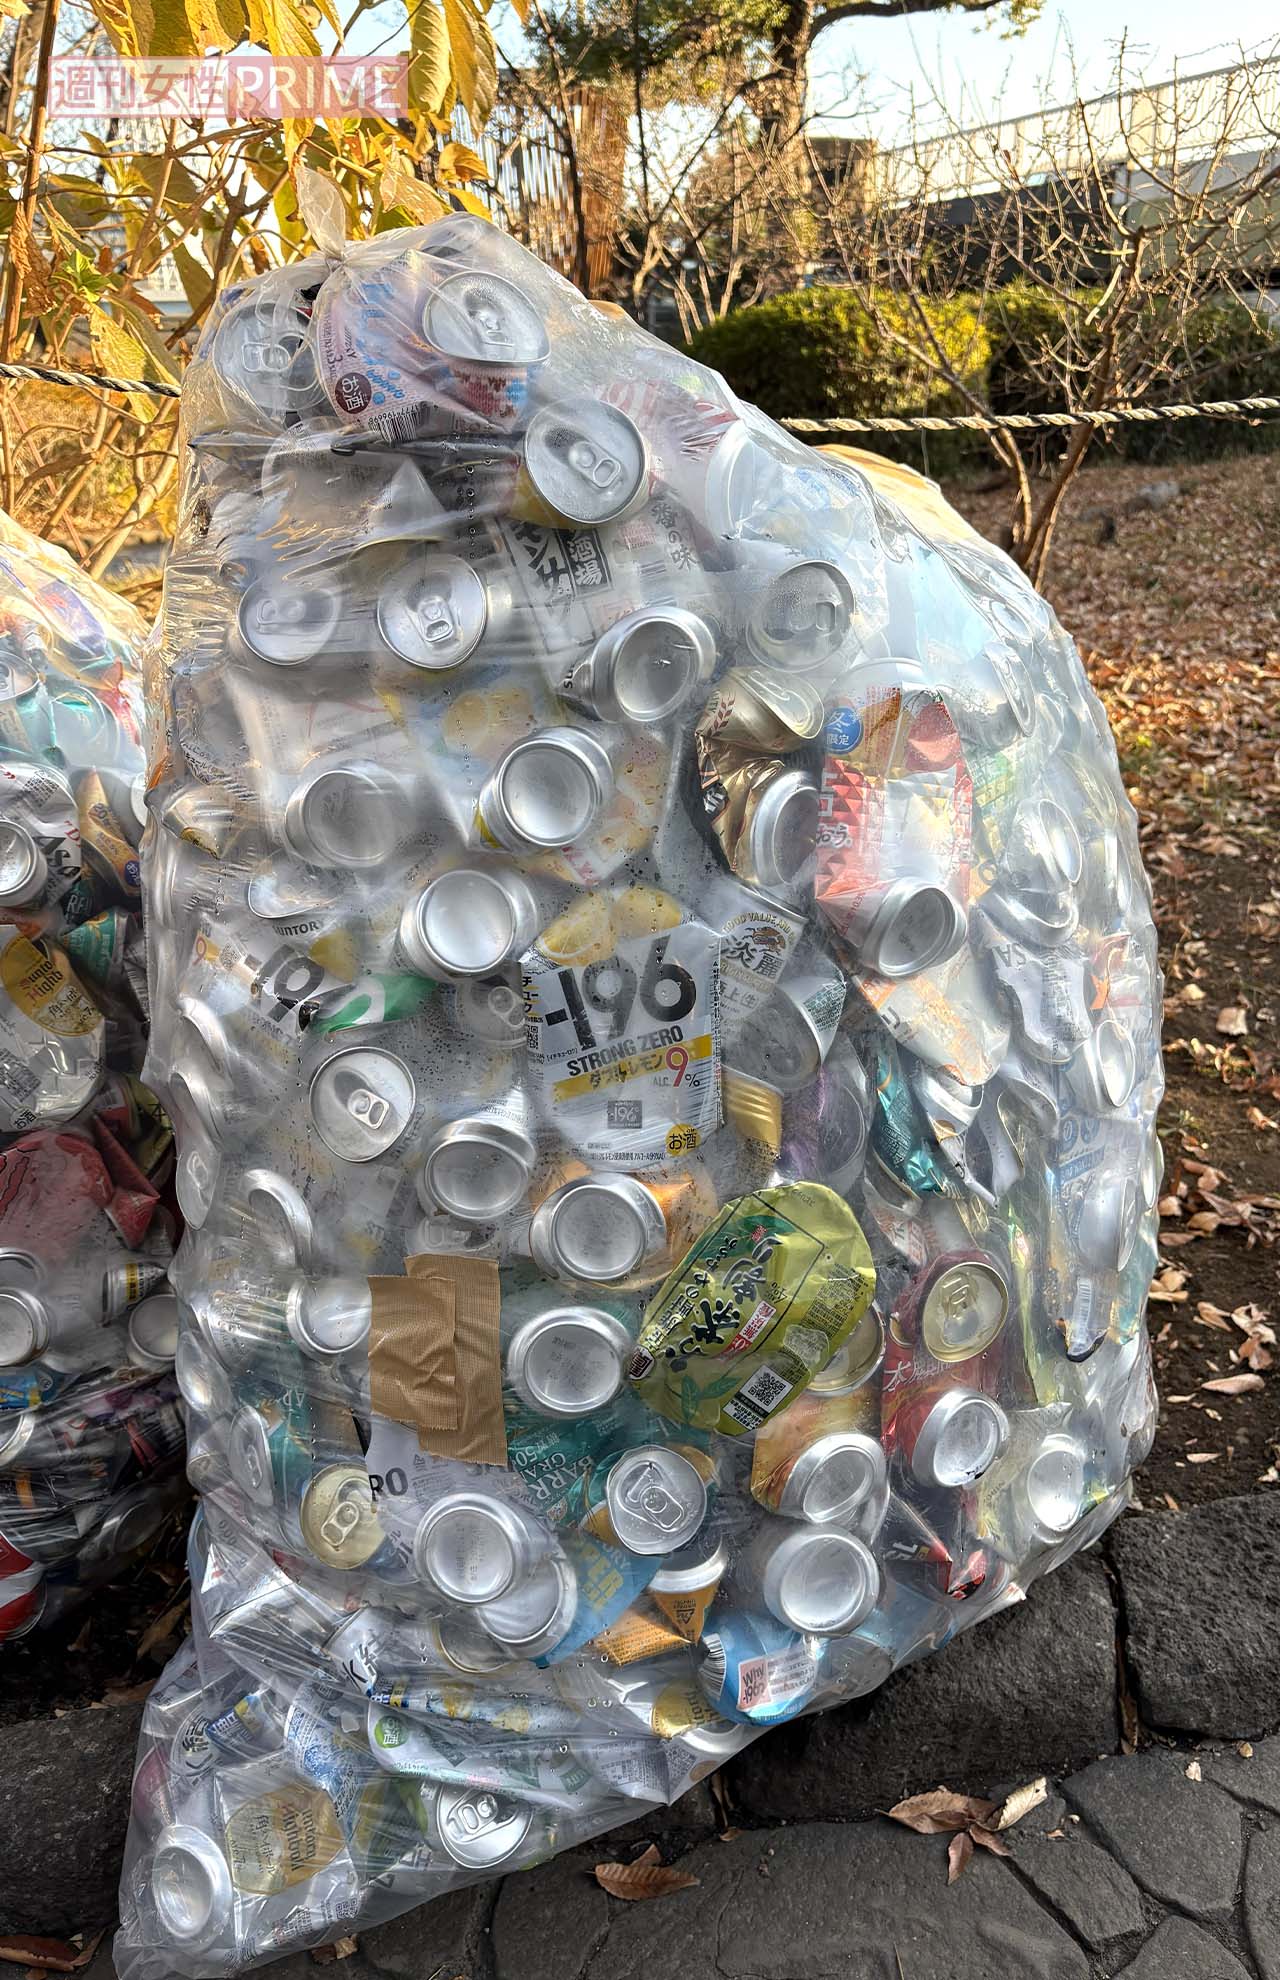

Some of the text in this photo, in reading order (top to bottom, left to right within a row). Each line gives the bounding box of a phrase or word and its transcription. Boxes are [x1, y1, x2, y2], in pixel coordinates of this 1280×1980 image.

[341, 374, 365, 411] お酒
[826, 732, 850, 747] 限定
[828, 710, 850, 734] 冬
[545, 933, 697, 1051] -196
[566, 1025, 685, 1078] STRONG ZERO
[668, 1129, 698, 1151] お酒
[368, 1466, 409, 1503] RO
